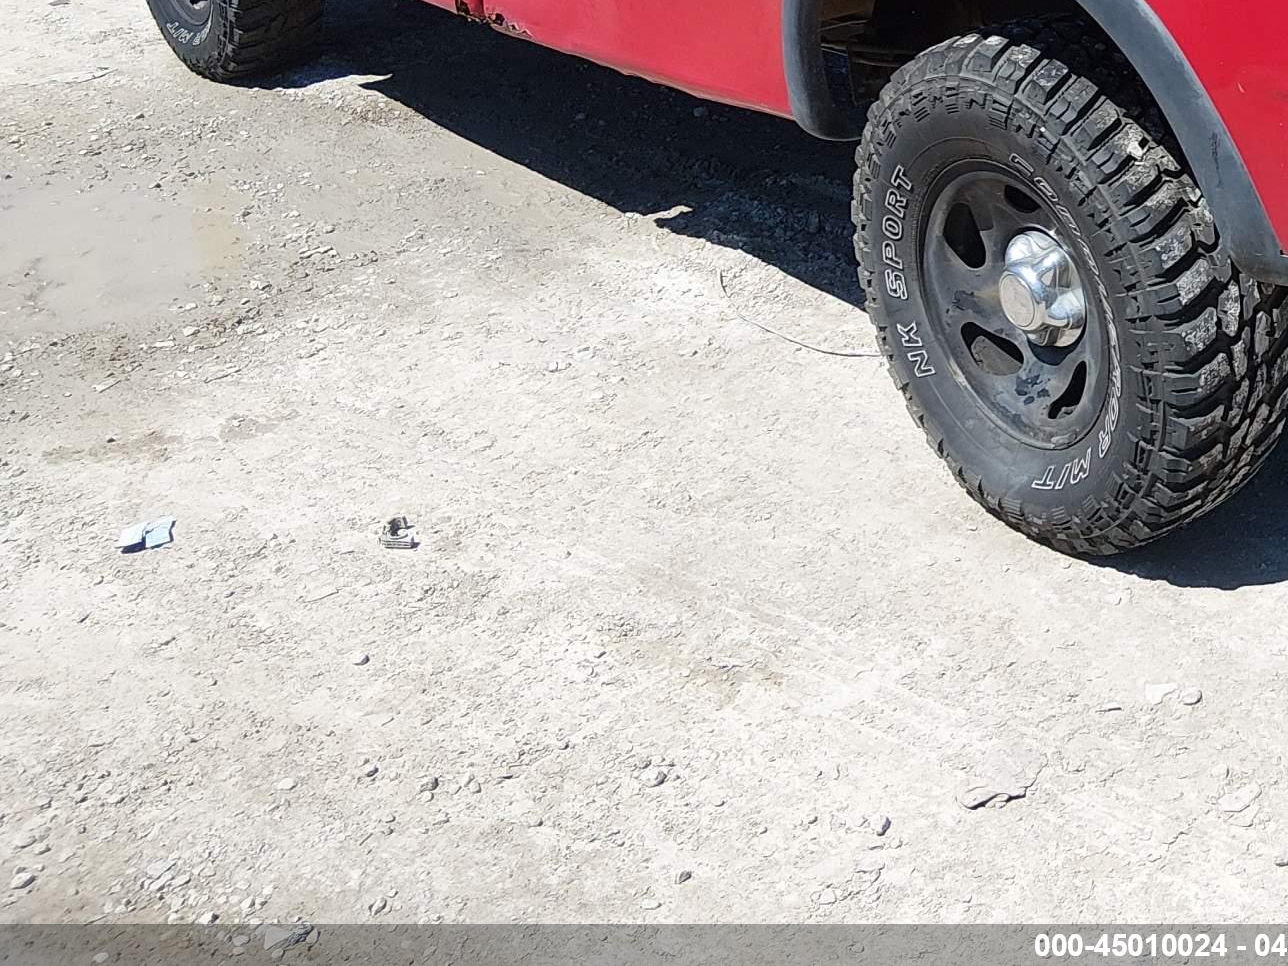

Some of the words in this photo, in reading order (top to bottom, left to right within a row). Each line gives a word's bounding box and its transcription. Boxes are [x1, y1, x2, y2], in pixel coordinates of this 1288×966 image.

[882, 164, 913, 300] SPORT
[896, 321, 936, 378] NK
[1031, 447, 1092, 491] M/T
